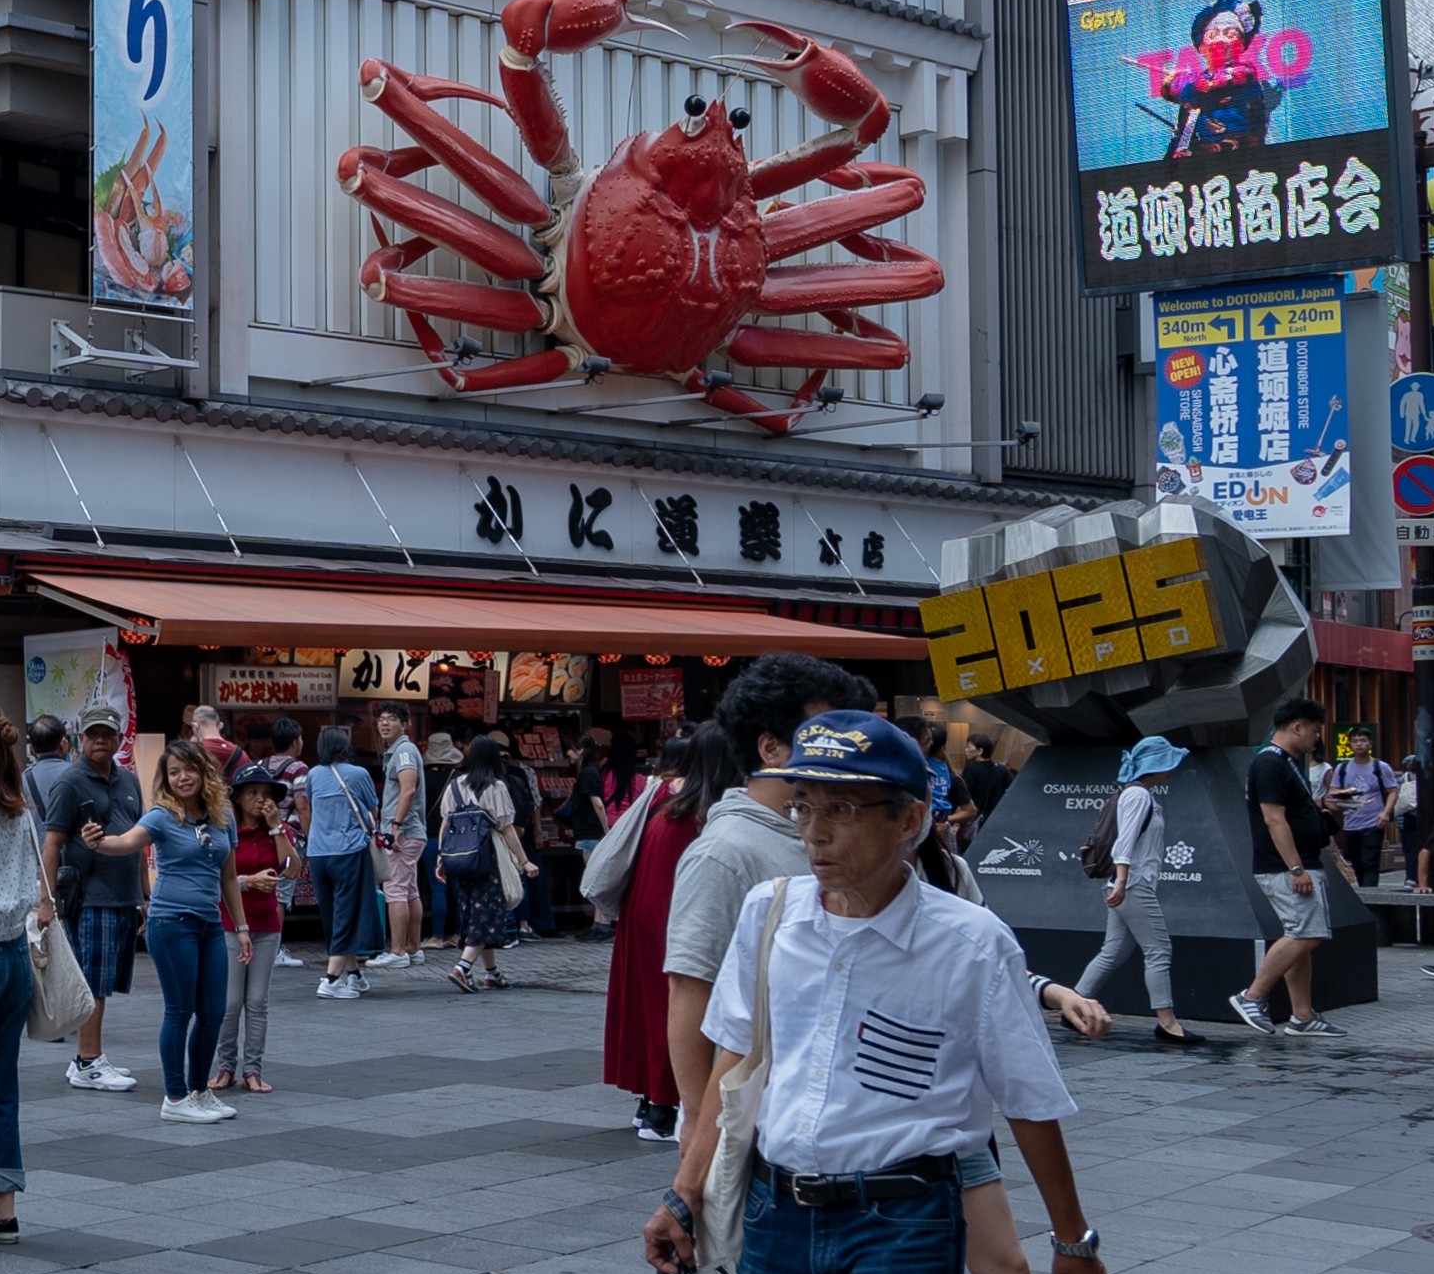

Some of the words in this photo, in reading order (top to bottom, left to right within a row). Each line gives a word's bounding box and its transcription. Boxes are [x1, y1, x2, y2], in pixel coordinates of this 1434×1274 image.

[1098, 155, 1382, 262] 道頓堀商店会
[1159, 300, 1209, 313] Welcome
[1212, 298, 1224, 309] to
[1227, 291, 1300, 307] DOTONBORI,
[1301, 287, 1335, 301] Japan
[1162, 318, 1206, 336] 340m
[1288, 308, 1335, 323] 240m
[1289, 325, 1308, 333] East
[1183, 334, 1208, 343] North
[1170, 366, 1203, 383] OPEN!
[1171, 355, 1196, 370] NEW
[1296, 340, 1308, 395] DOTONBORI
[1179, 390, 1190, 421] STORE
[1298, 397, 1310, 429] STORE
[1192, 389, 1203, 453] SHINSAIBASHI
[472, 473, 783, 564] かに道楽
[920, 537, 1220, 703] 2025
[352, 649, 422, 693] かに
[218, 680, 300, 705] かに炭火焼
